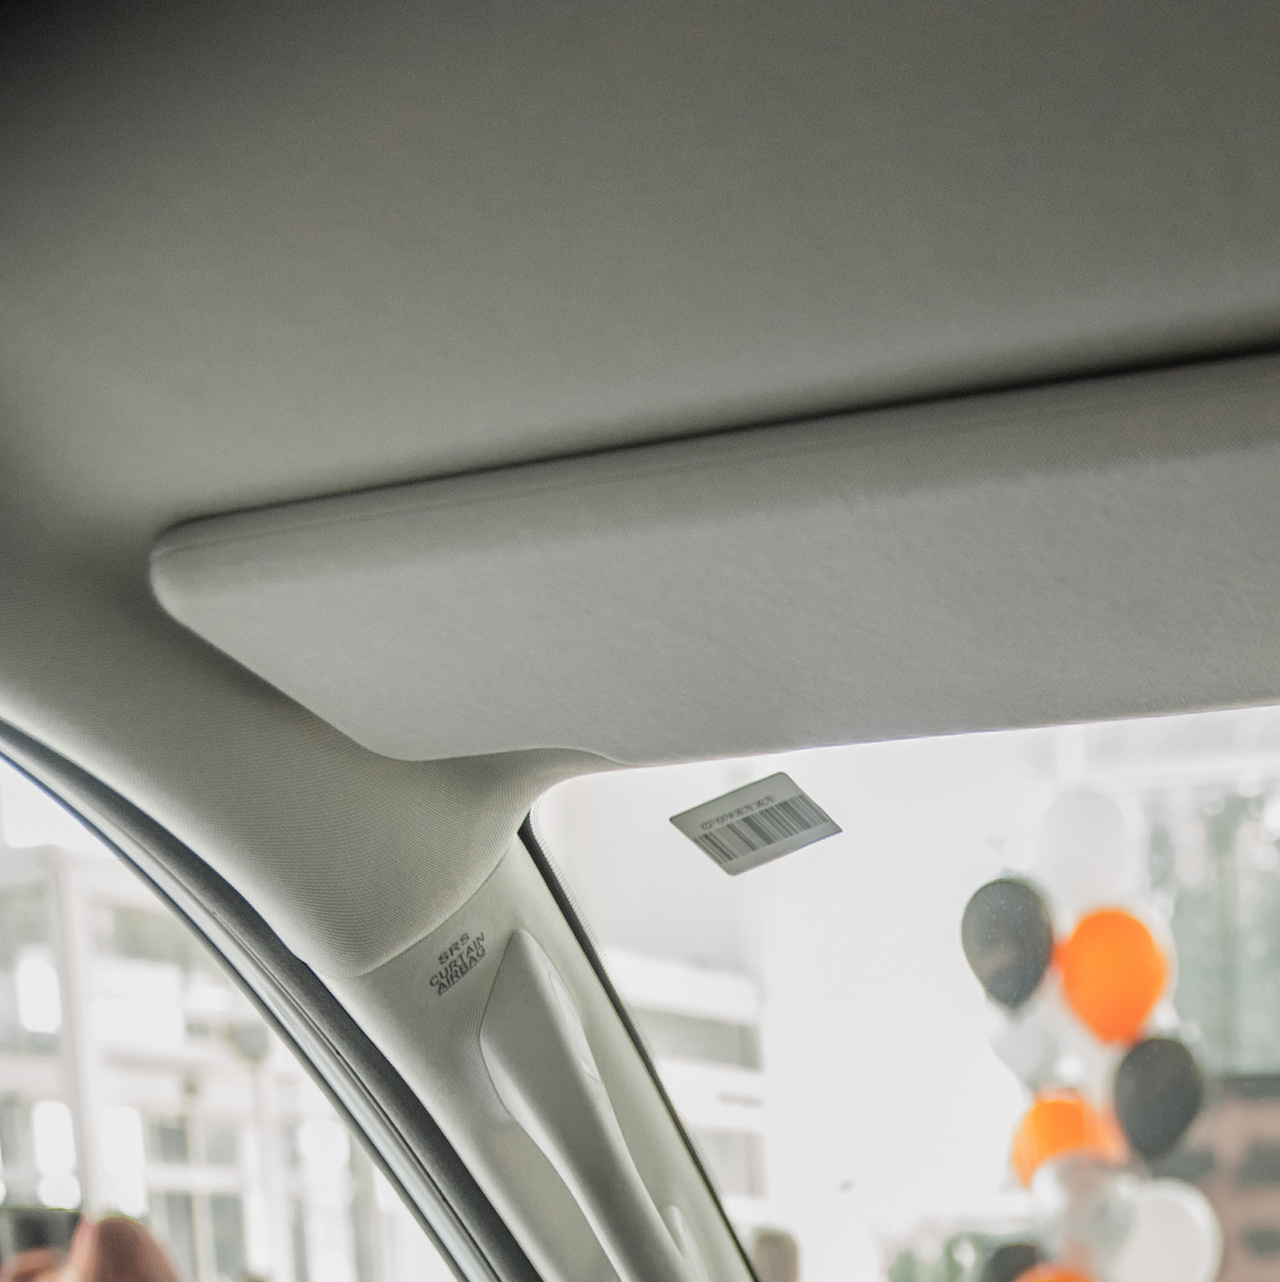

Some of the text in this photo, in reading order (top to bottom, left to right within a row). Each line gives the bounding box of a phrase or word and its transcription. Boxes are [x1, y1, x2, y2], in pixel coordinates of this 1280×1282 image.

[429, 932, 485, 987] CURTAIN
[437, 946, 486, 996] AIRBAG
[438, 932, 470, 965] SRS
